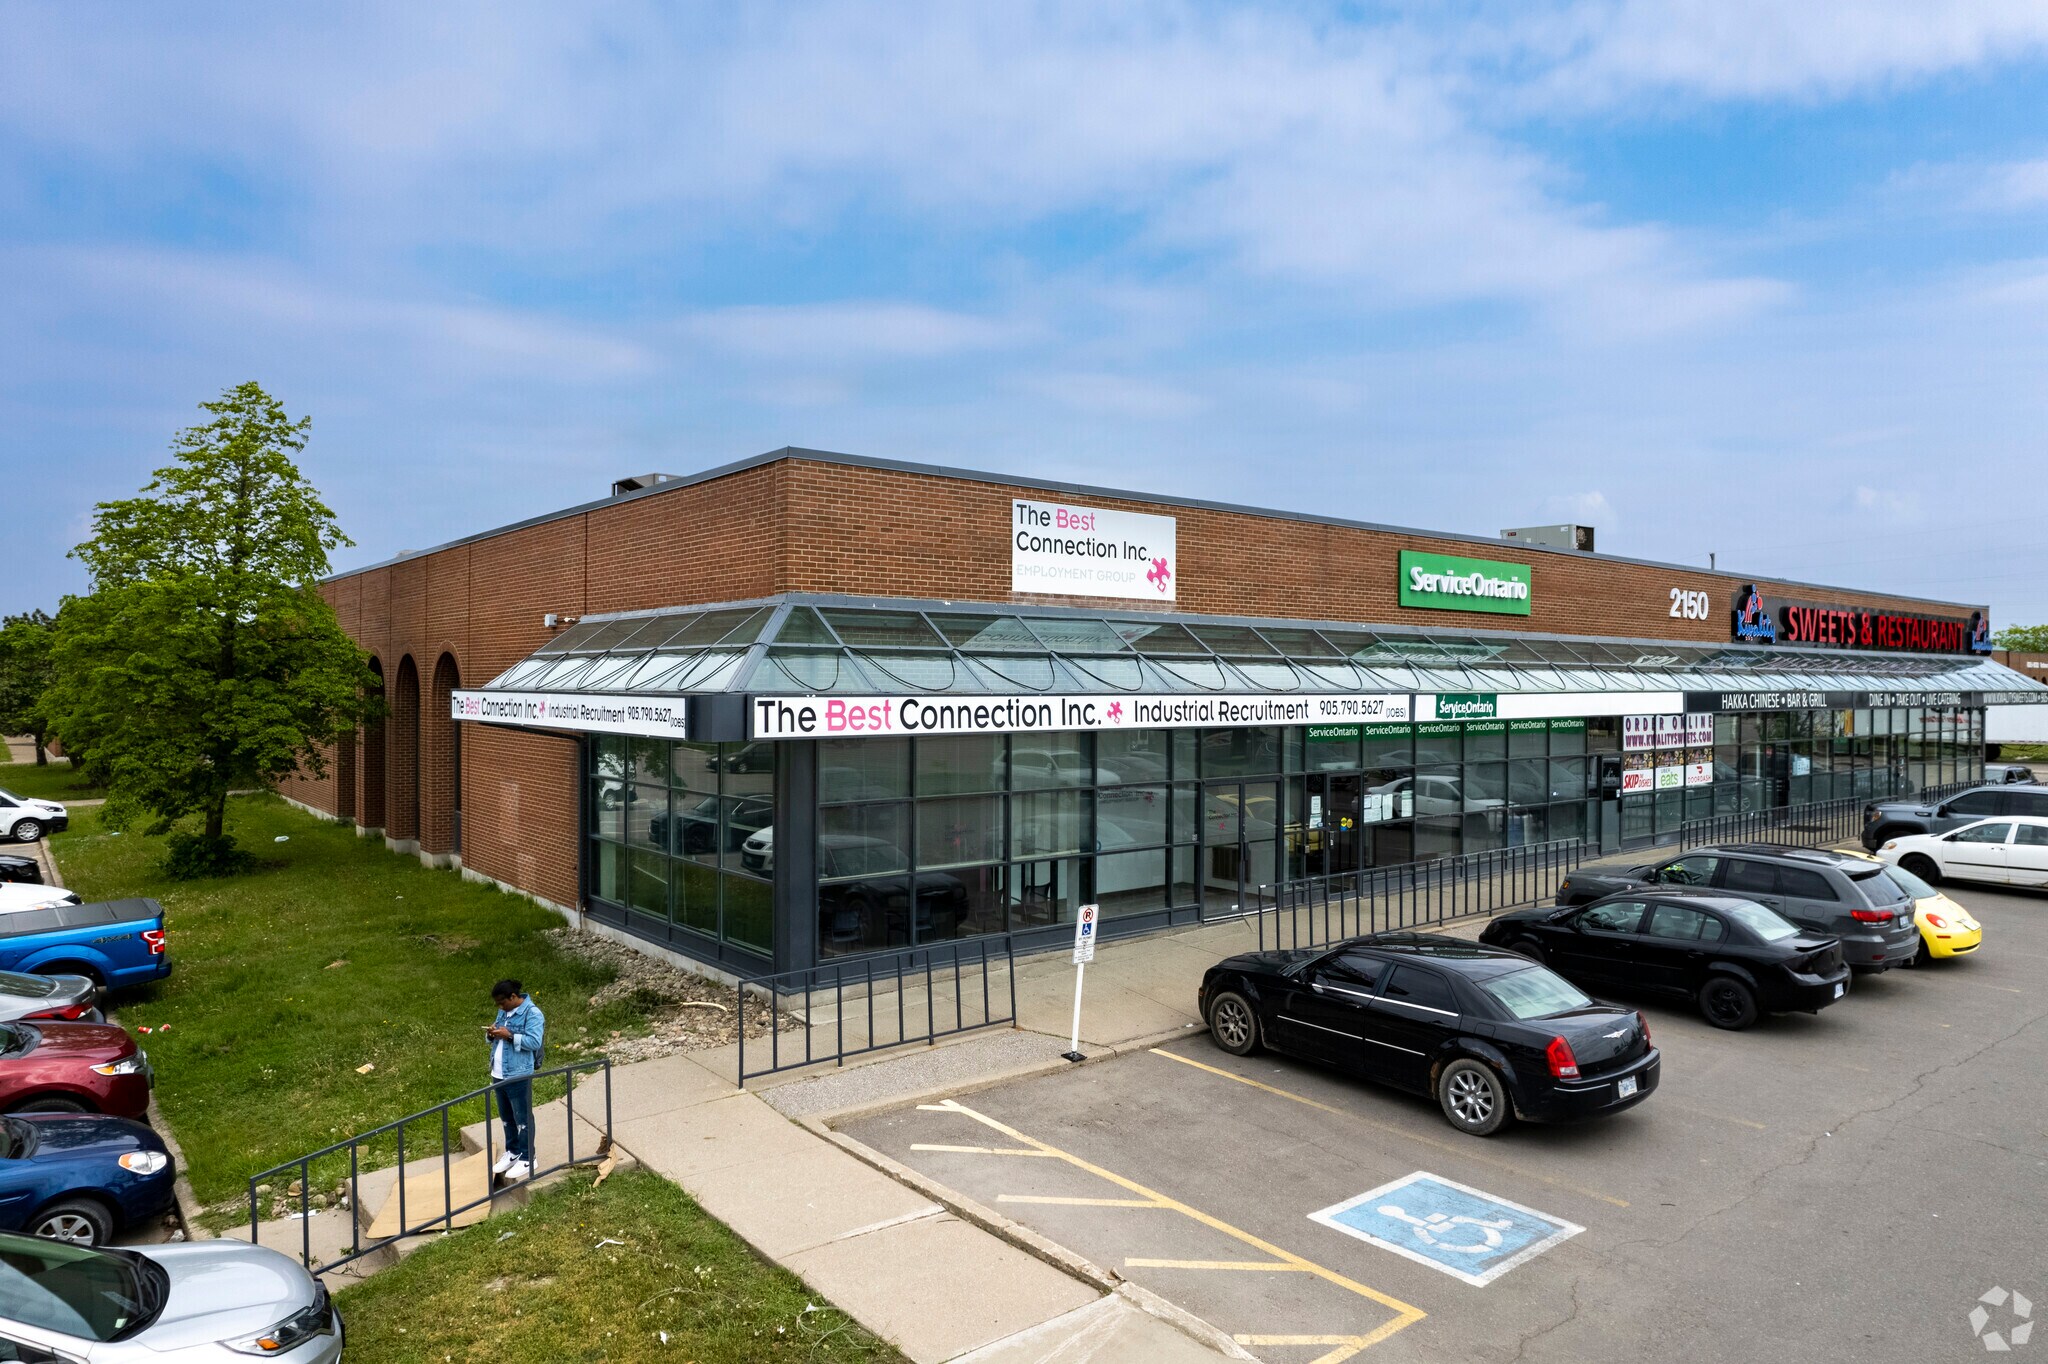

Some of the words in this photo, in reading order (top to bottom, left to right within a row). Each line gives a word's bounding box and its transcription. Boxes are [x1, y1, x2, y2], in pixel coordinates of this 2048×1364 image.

[1016, 504, 1051, 527] The
[1056, 509, 1095, 531] Best
[1016, 531, 1117, 559] Connection
[1123, 541, 1151, 562] Inc.
[1016, 564, 1094, 580] EMPLOYMENT
[1097, 571, 1136, 583] GROUP
[1410, 566, 1527, 600] ServiceOntario
[1669, 587, 1709, 621] 2150
[1788, 606, 1857, 645] SWEETS
[1861, 612, 1873, 645] &
[1878, 615, 1964, 650] RESTAURANT
[1439, 700, 1494, 714] ServiceOntario
[1722, 694, 1748, 709] HAKKA
[1749, 693, 1780, 708] CHINESE
[1787, 693, 1801, 707] BAR
[1802, 693, 1808, 707] &
[1809, 693, 1827, 707] GRILL
[1869, 693, 1883, 706] DINE
[1884, 693, 1891, 706] IN
[1896, 693, 1909, 706] TAKE
[1910, 693, 1921, 706] OUT
[1926, 693, 1937, 706] LIVE
[1937, 692, 1961, 705] CATERING
[453, 697, 464, 714] The
[465, 698, 480, 715] Best
[481, 698, 523, 718] Connection
[524, 700, 540, 719] Inc.
[549, 703, 579, 720] Industrial
[581, 705, 625, 723] Recruitment
[628, 706, 671, 722] 905.790.5627
[757, 700, 817, 733] The
[825, 699, 892, 731] Best
[900, 698, 1052, 730] Connection
[1061, 698, 1102, 726] Inc.
[1135, 700, 1214, 723] Industrial
[1218, 699, 1309, 722] Recruitment
[1319, 700, 1384, 716] 905.790.5627
[1386, 707, 1406, 719] (JOBS)
[1366, 725, 1411, 736] ServiceOntario
[1418, 723, 1460, 733] ServiceOntario
[1466, 721, 1505, 731] ServiceOntario
[1510, 720, 1546, 730] ServiceOntario
[1551, 719, 1584, 728] ServiceOntario
[1625, 717, 1664, 732] ORDER
[1672, 715, 1712, 731] ONLINE
[1309, 727, 1358, 738] ServiceOntario
[1624, 773, 1639, 789] SKIP
[1660, 773, 1678, 786] eats
